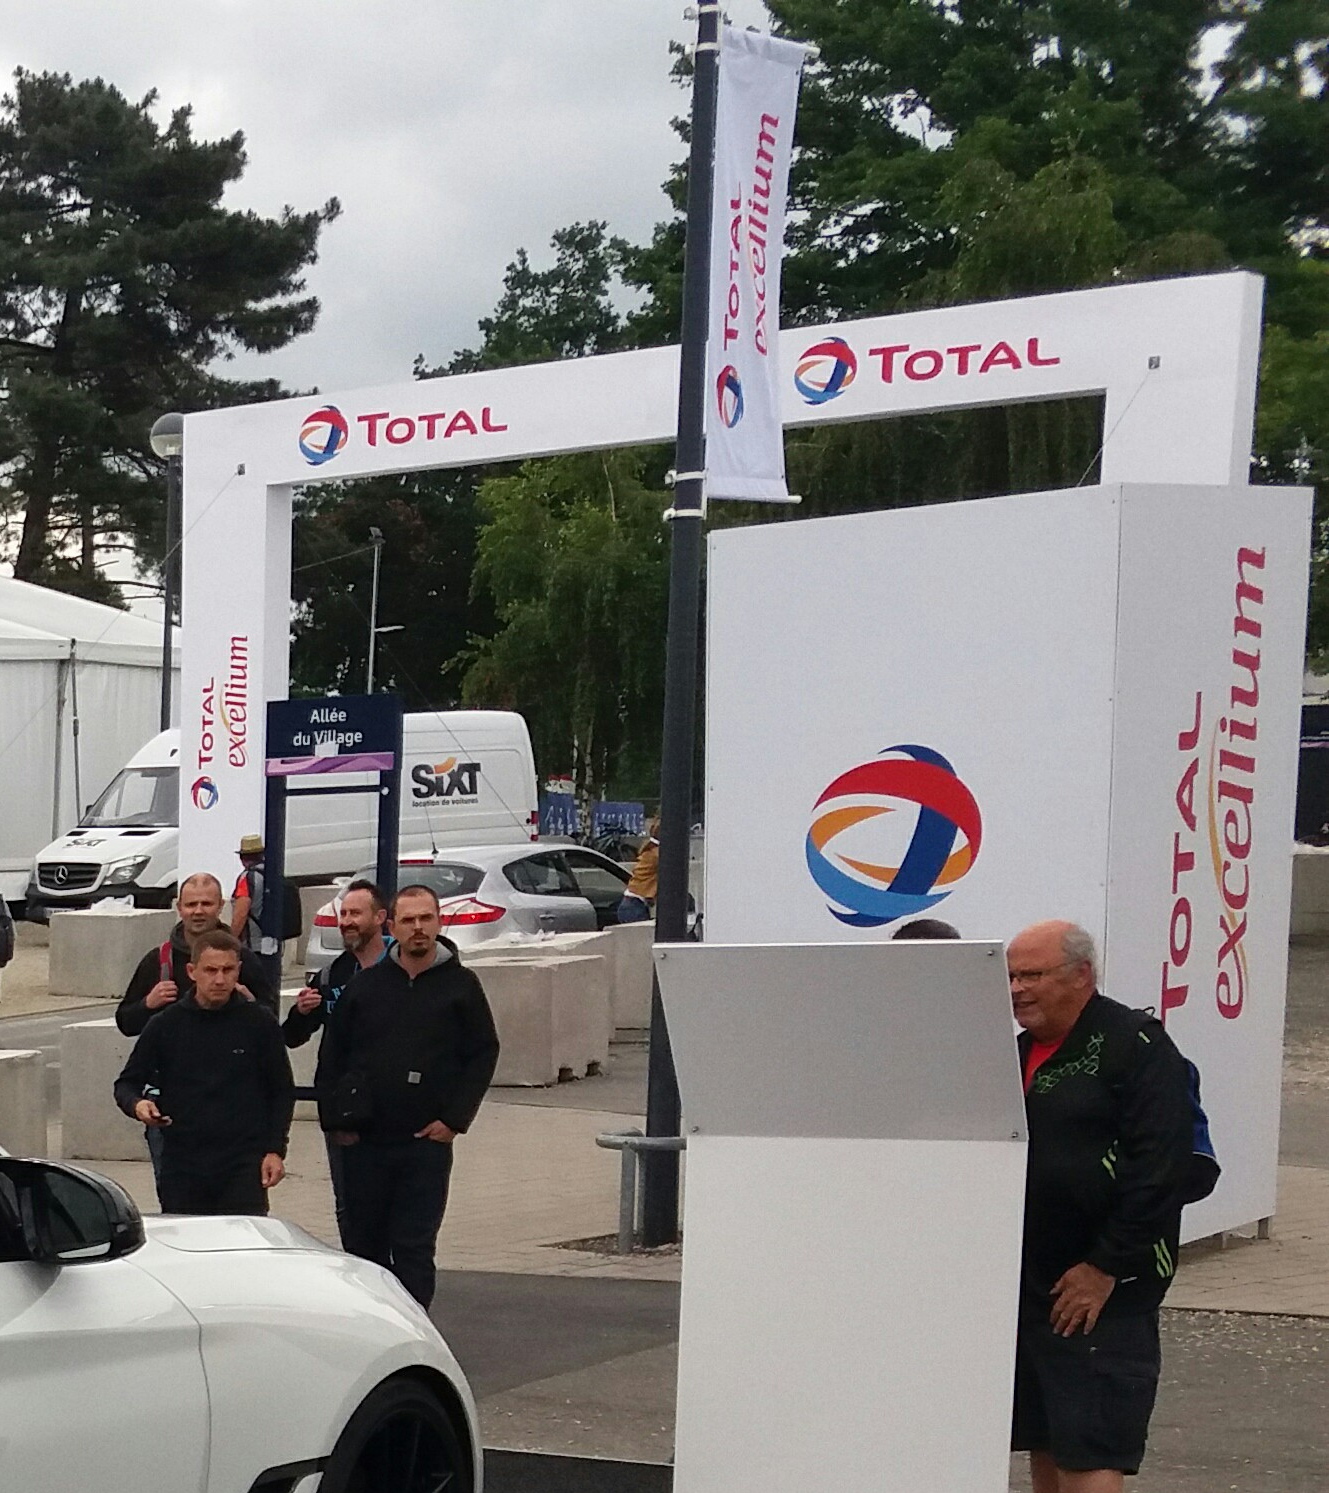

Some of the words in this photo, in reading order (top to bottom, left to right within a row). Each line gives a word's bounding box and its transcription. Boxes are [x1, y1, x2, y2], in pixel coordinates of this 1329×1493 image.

[723, 181, 742, 352] TOTAL
[748, 112, 780, 356] excellium
[868, 337, 1061, 384] TOTAL
[357, 407, 508, 447] TOTAL
[198, 676, 215, 770] TOTAL
[224, 635, 248, 768] excellium
[293, 731, 311, 747] du
[313, 730, 363, 747] Village
[310, 708, 347, 724] Allée
[1215, 546, 1266, 1020] excellium
[1161, 691, 1202, 1028] TOTAL
